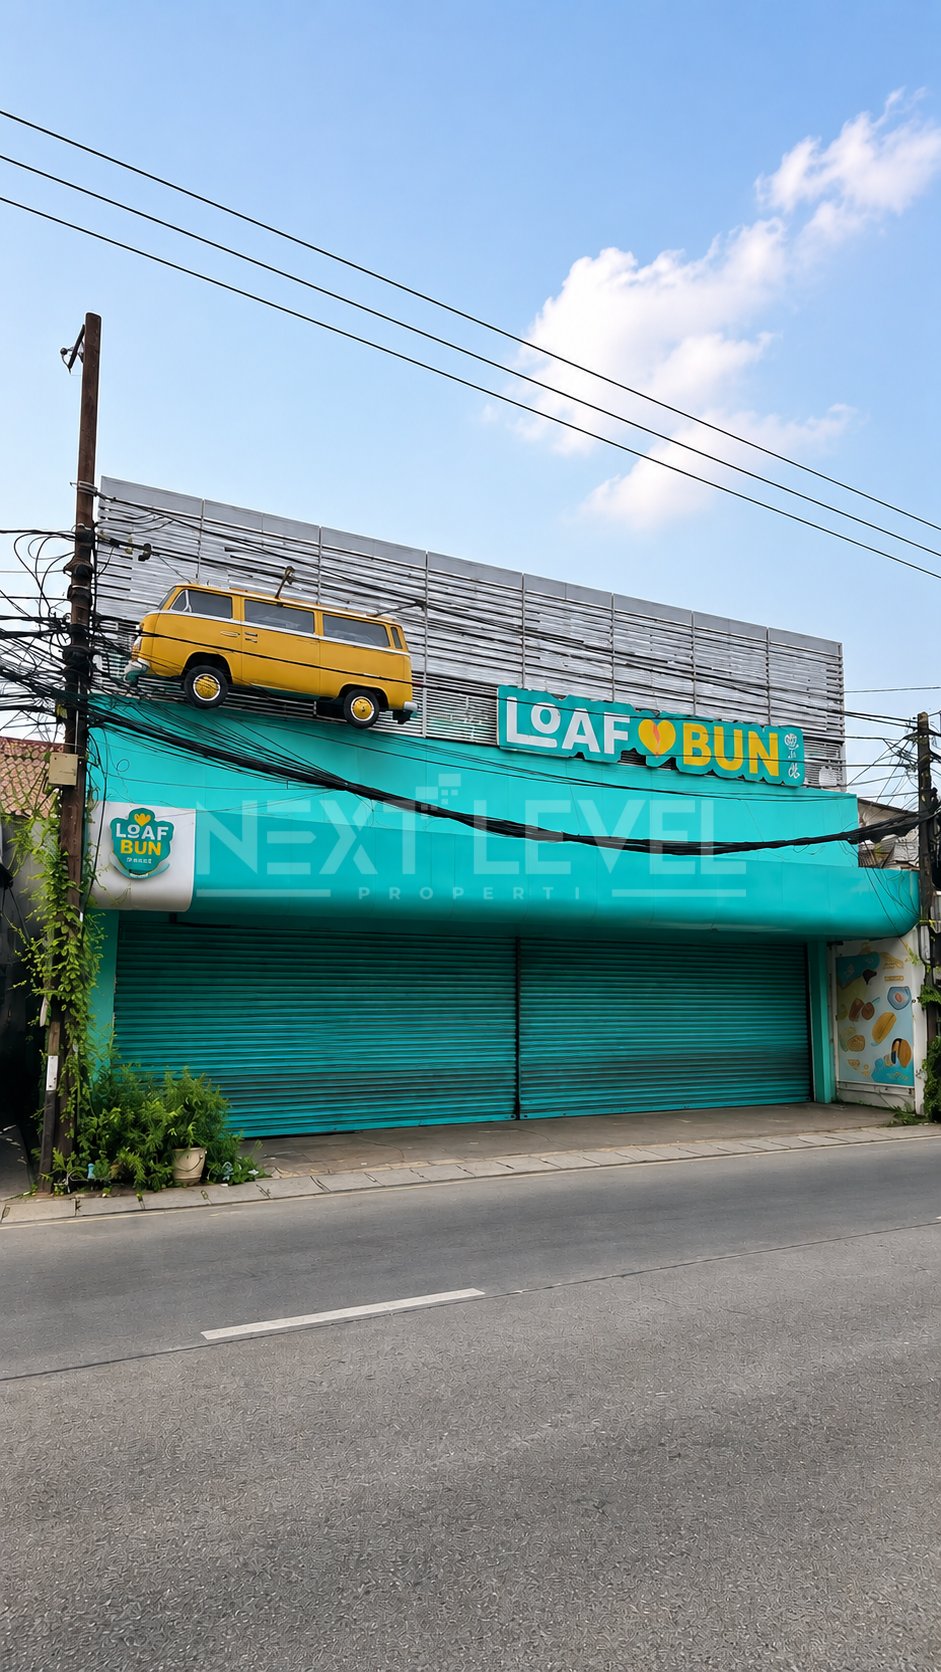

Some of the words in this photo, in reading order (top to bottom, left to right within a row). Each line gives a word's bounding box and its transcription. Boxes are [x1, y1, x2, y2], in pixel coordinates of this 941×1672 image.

[506, 696, 631, 755] LOAF
[682, 722, 780, 777] BUN
[116, 823, 168, 841] LOAF
[120, 839, 162, 856] BUN
